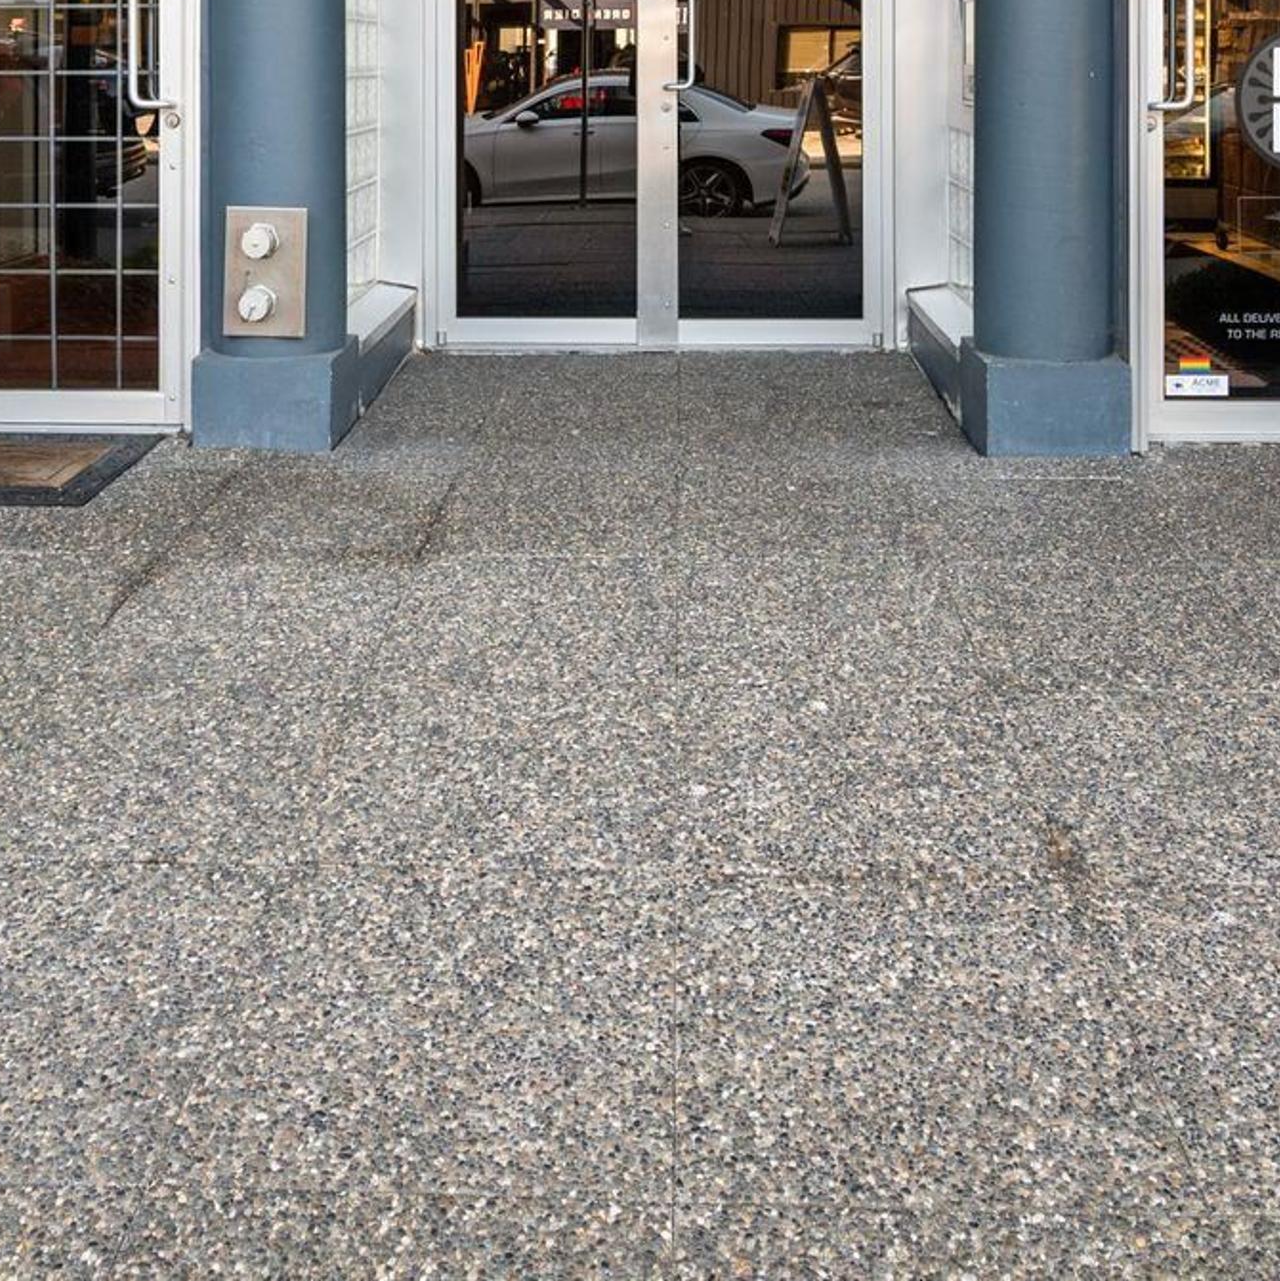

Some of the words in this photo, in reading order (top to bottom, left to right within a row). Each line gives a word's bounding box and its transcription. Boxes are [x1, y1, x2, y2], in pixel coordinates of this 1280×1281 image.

[1220, 312, 1240, 324] ALL
[1227, 329, 1242, 340] TO
[1245, 329, 1267, 340] THE
